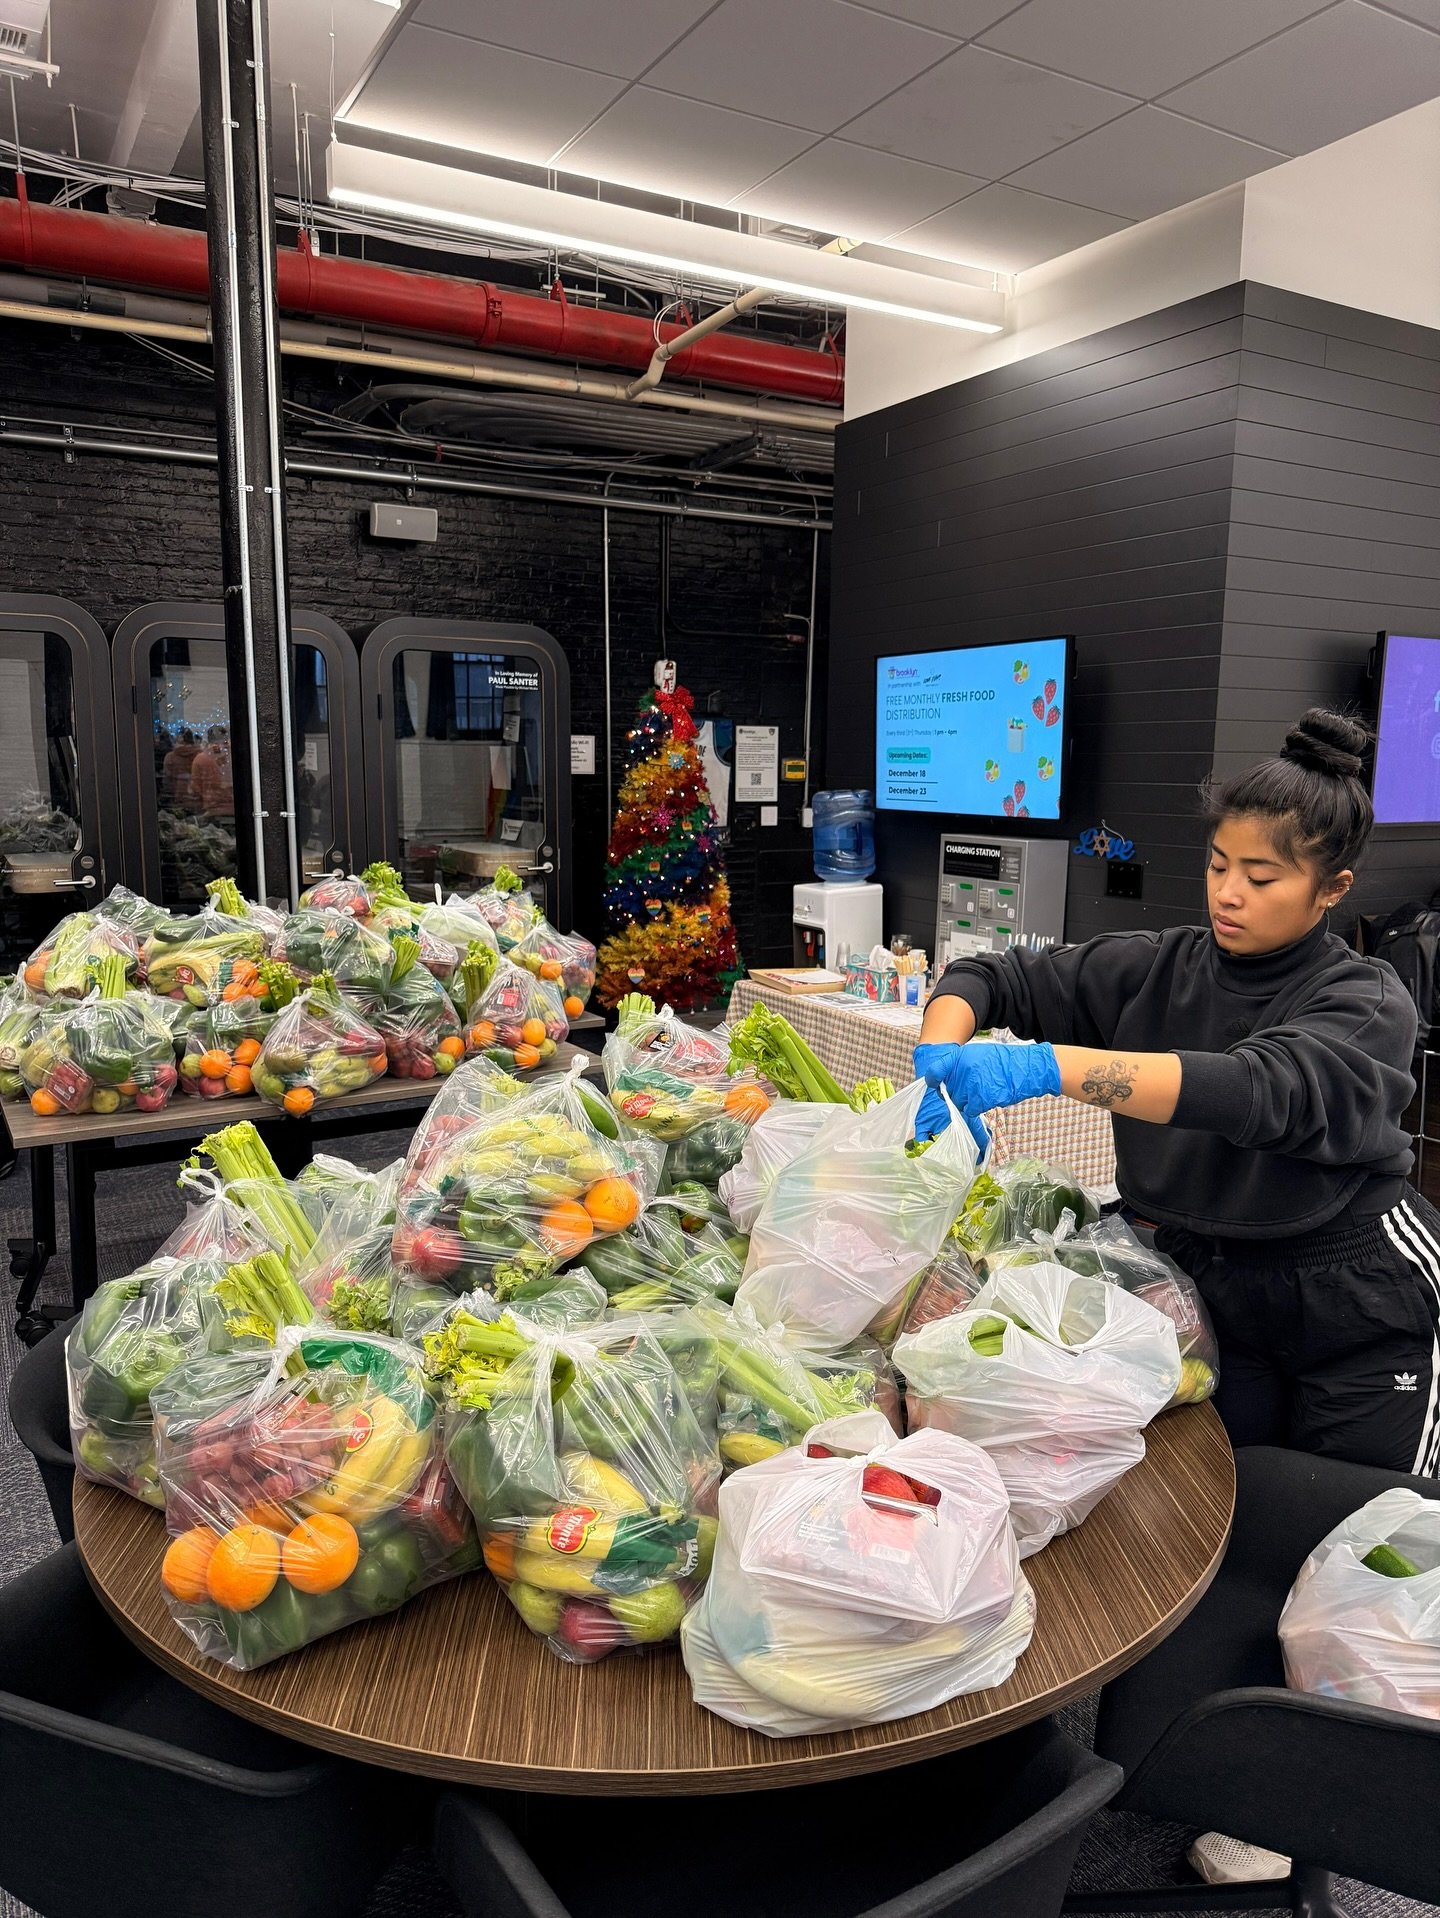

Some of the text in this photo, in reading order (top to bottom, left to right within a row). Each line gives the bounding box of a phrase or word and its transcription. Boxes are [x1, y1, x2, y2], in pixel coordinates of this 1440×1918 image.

[488, 677, 538, 686] PAUL SANTER
[886, 690, 995, 706] FREE MONTHLY FRESH FOOD
[886, 707, 941, 721] DISTRIBUTION
[889, 752, 912, 760] Upcoming
[888, 769, 926, 778] December 18
[888, 786, 927, 795] December 23
[946, 845, 1000, 857] CHARGING STATION
